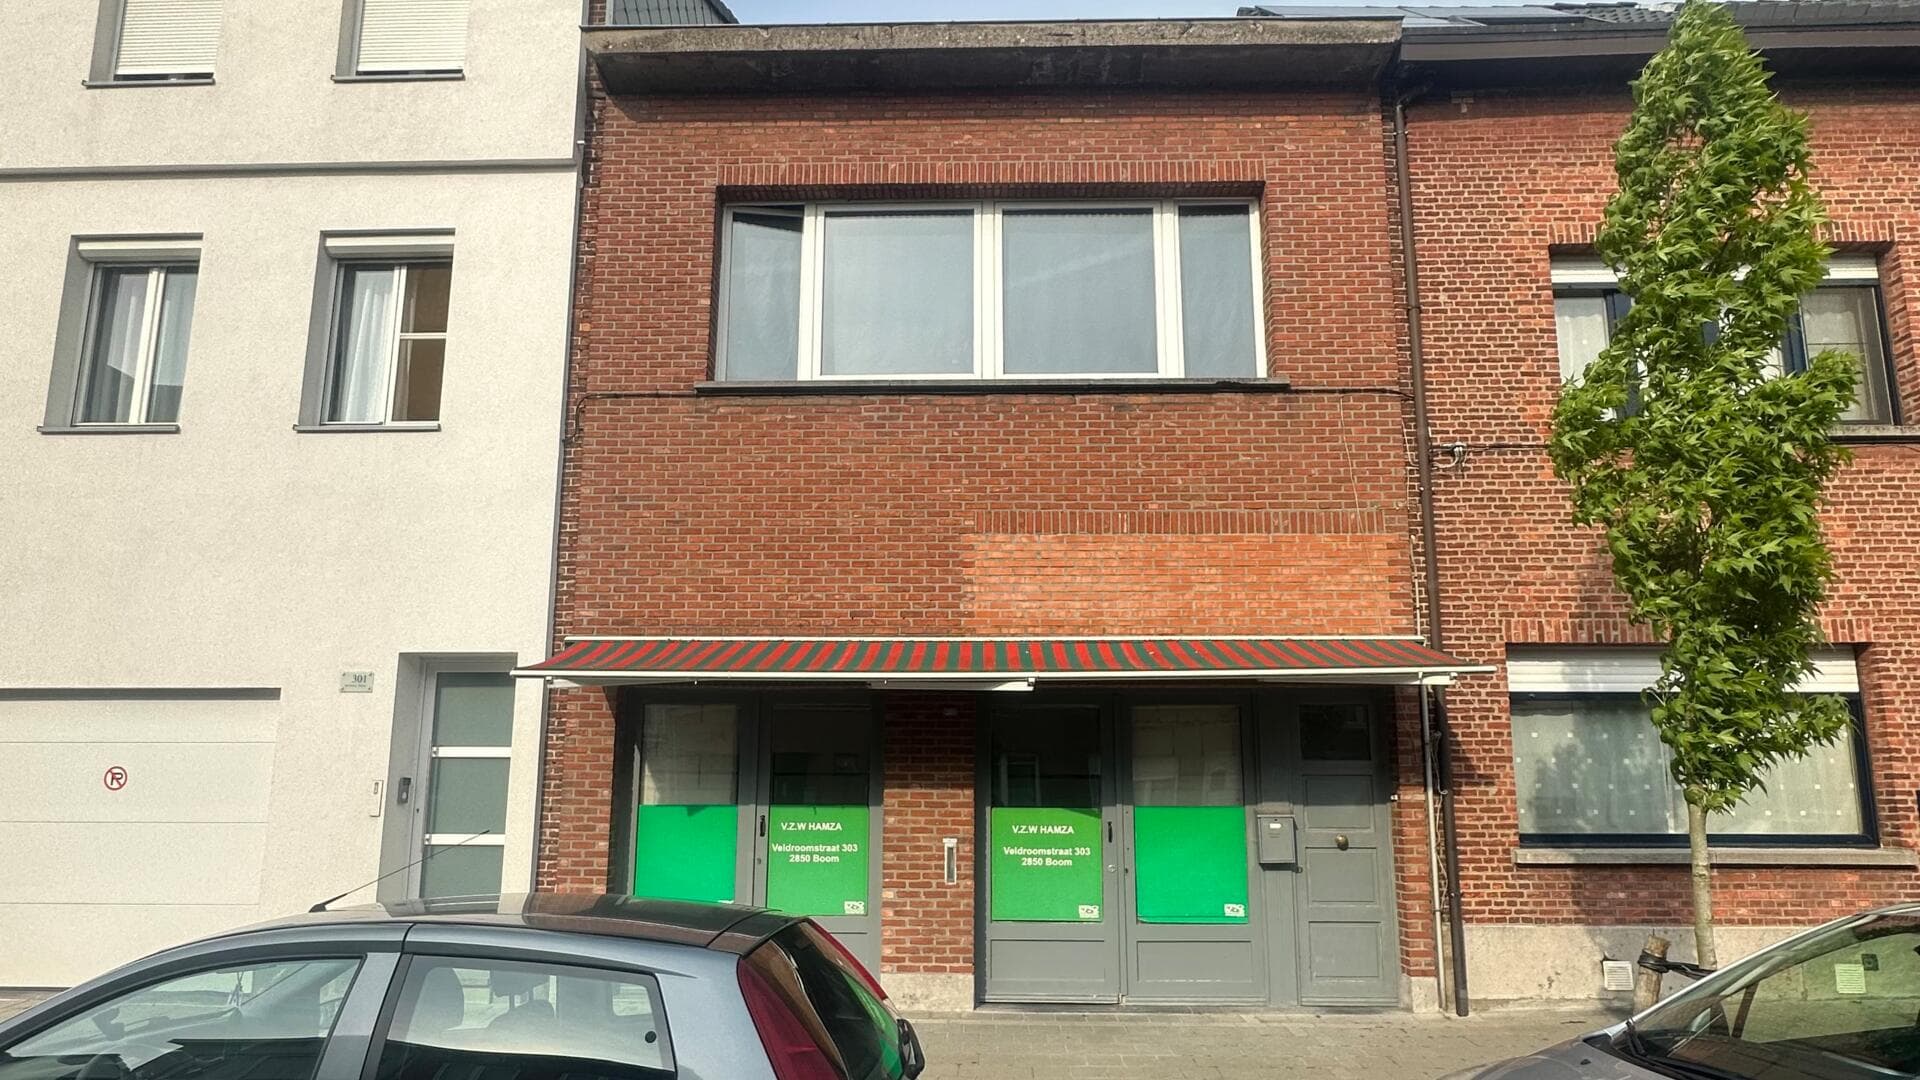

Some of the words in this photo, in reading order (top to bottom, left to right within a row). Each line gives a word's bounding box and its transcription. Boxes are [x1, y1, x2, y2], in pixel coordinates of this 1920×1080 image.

[780, 822, 807, 831] V.Z.W
[808, 822, 843, 831] HAMZA
[1011, 825, 1038, 834] V.Z.W
[1039, 825, 1075, 834] HAMZA
[772, 843, 840, 852] Veldroomstraat
[841, 843, 858, 852] 303
[1003, 847, 1073, 856] Veldroomstraat
[1074, 847, 1091, 856] 303
[789, 854, 811, 863] 2850
[812, 854, 840, 863] Boom
[1021, 857, 1043, 866] 2850
[1045, 857, 1073, 866] Boom
